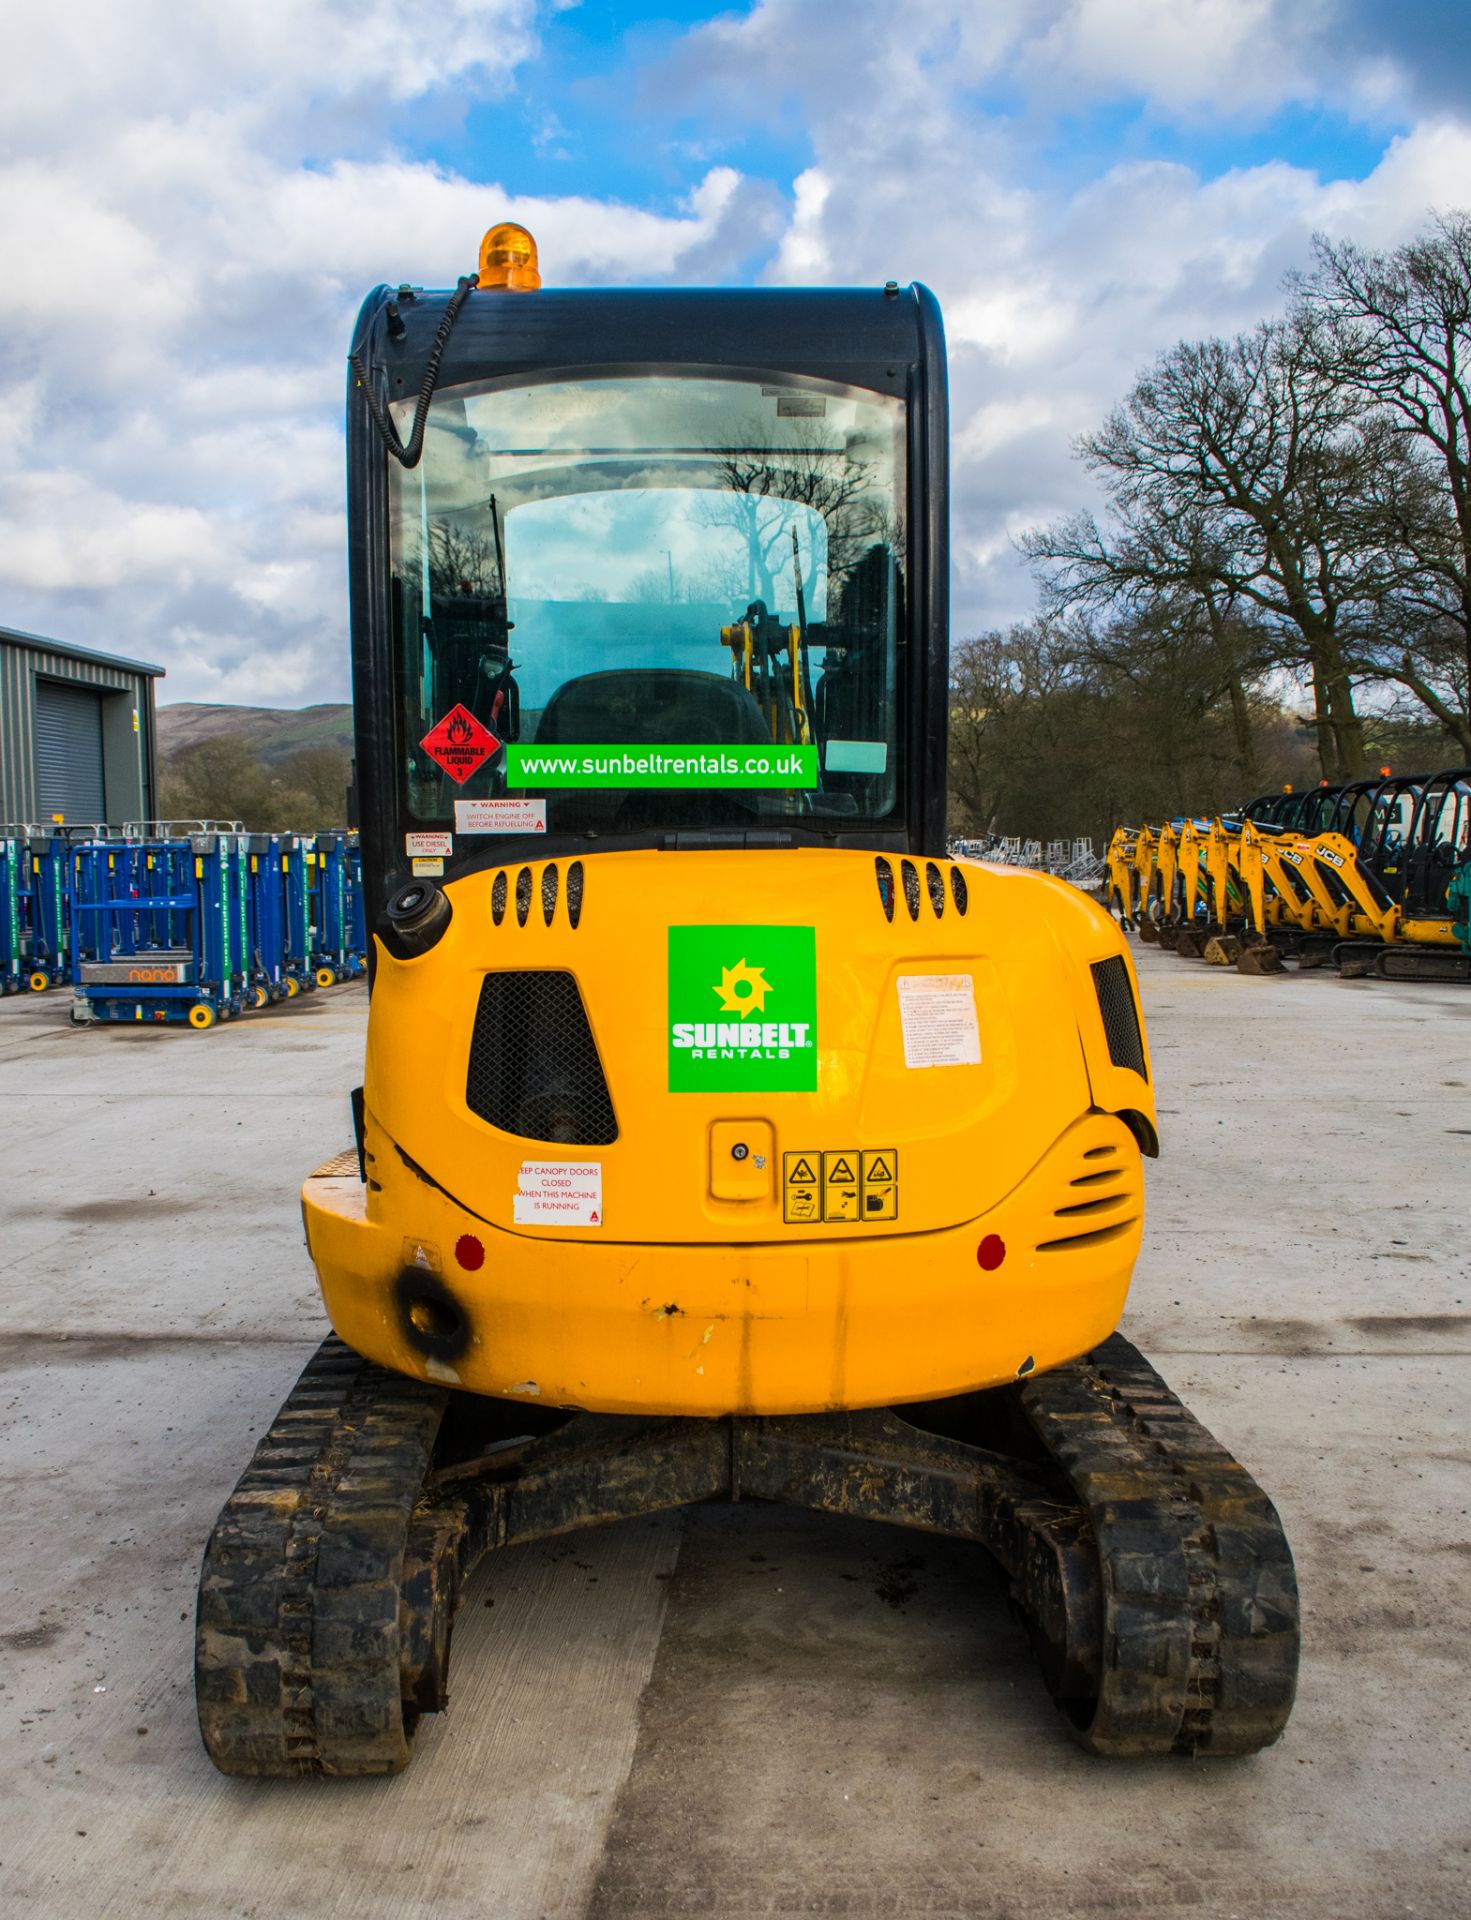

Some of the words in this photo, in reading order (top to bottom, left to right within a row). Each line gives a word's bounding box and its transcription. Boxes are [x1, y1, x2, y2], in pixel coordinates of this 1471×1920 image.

[434, 747, 486, 756] FLAMMABLE
[446, 757, 473, 765] LIQUID
[520, 753, 804, 775] www.sunbeltrentals.co.uk
[456, 768, 463, 777] 3
[494, 820, 534, 828] REFUELLING
[1315, 845, 1345, 867] JCB
[672, 1023, 810, 1048] SUNBELT
[692, 1049, 790, 1059] RENTALS
[534, 1167, 568, 1176] CANOPY
[569, 1168, 599, 1176] DOORS
[541, 1179, 572, 1187] CLOSED
[543, 1190, 560, 1199] THIS
[561, 1191, 597, 1200] MACHINE
[534, 1202, 541, 1210] IS
[542, 1202, 580, 1211] RUNNING
